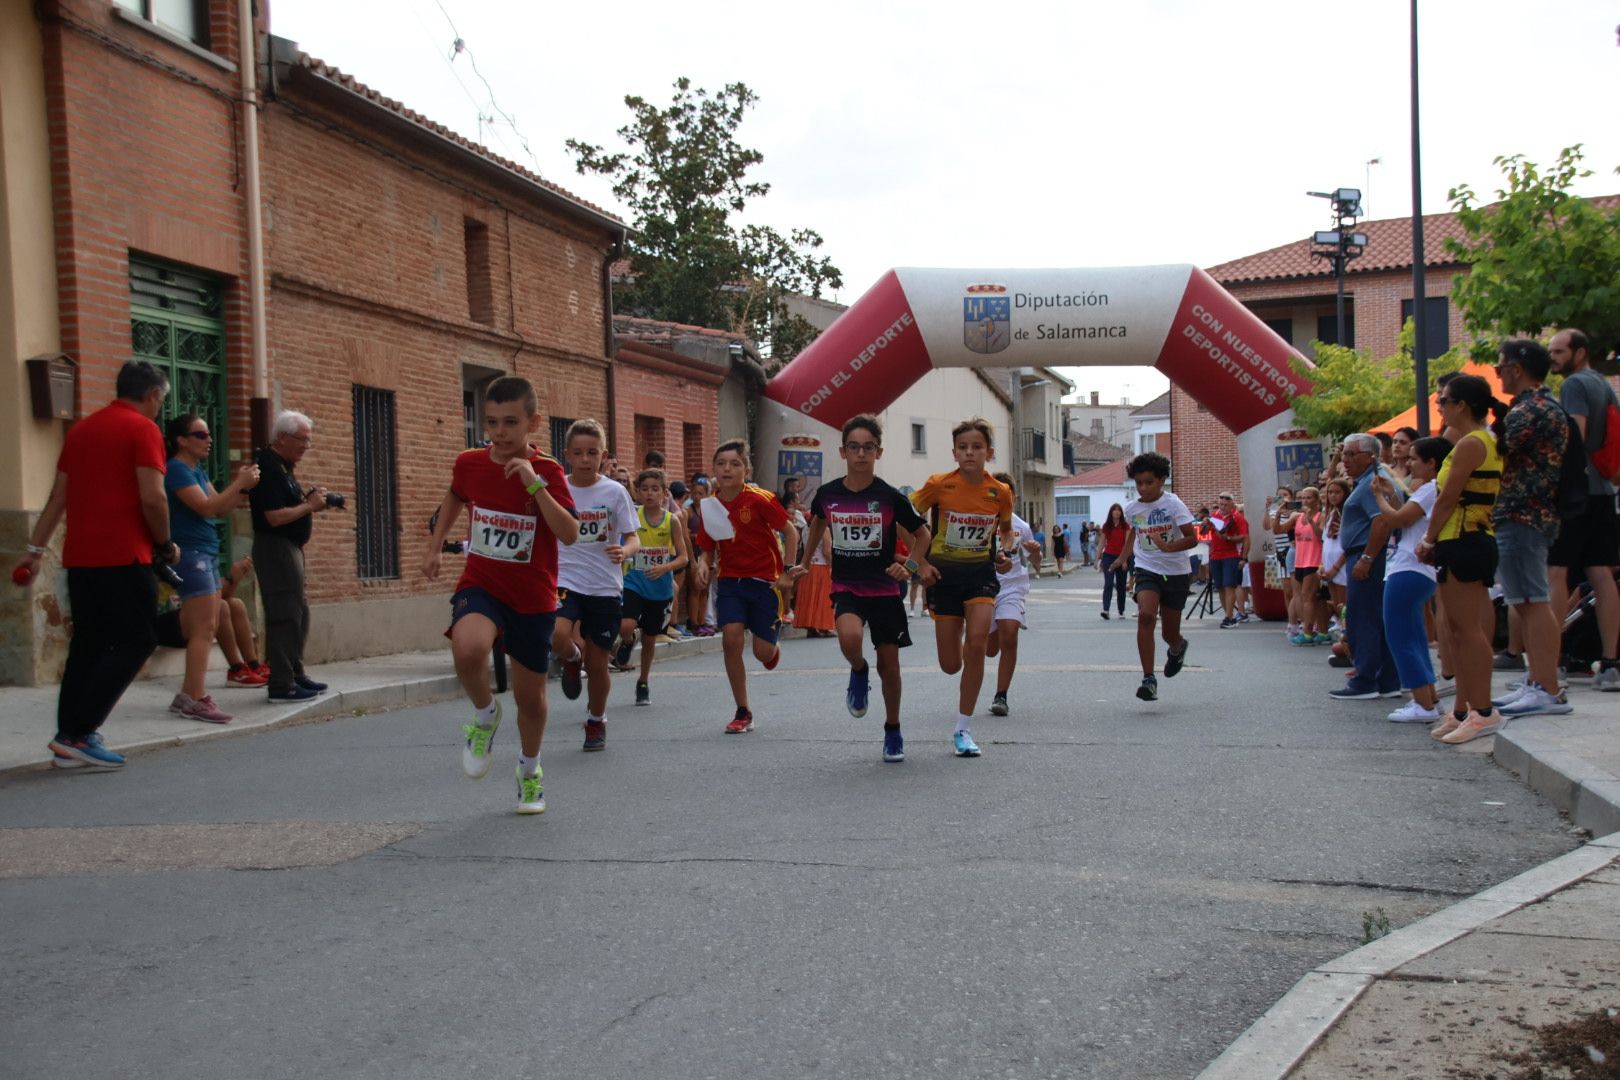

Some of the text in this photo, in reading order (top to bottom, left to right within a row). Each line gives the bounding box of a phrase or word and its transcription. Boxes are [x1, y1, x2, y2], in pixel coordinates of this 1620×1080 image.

[1014, 291, 1109, 312] Diputación
[1014, 323, 1127, 340] de Salamanca
[1191, 304, 1298, 396] CON NUESTROS
[800, 312, 914, 414] CON EL DEPORTE
[1182, 324, 1277, 406] DEPORTISTAS
[831, 514, 881, 525] bedunia
[482, 527, 520, 550] 170
[840, 526, 872, 541] 159
[958, 526, 985, 540] 172
[1145, 532, 1168, 546] 15
[1262, 541, 1273, 552] de
